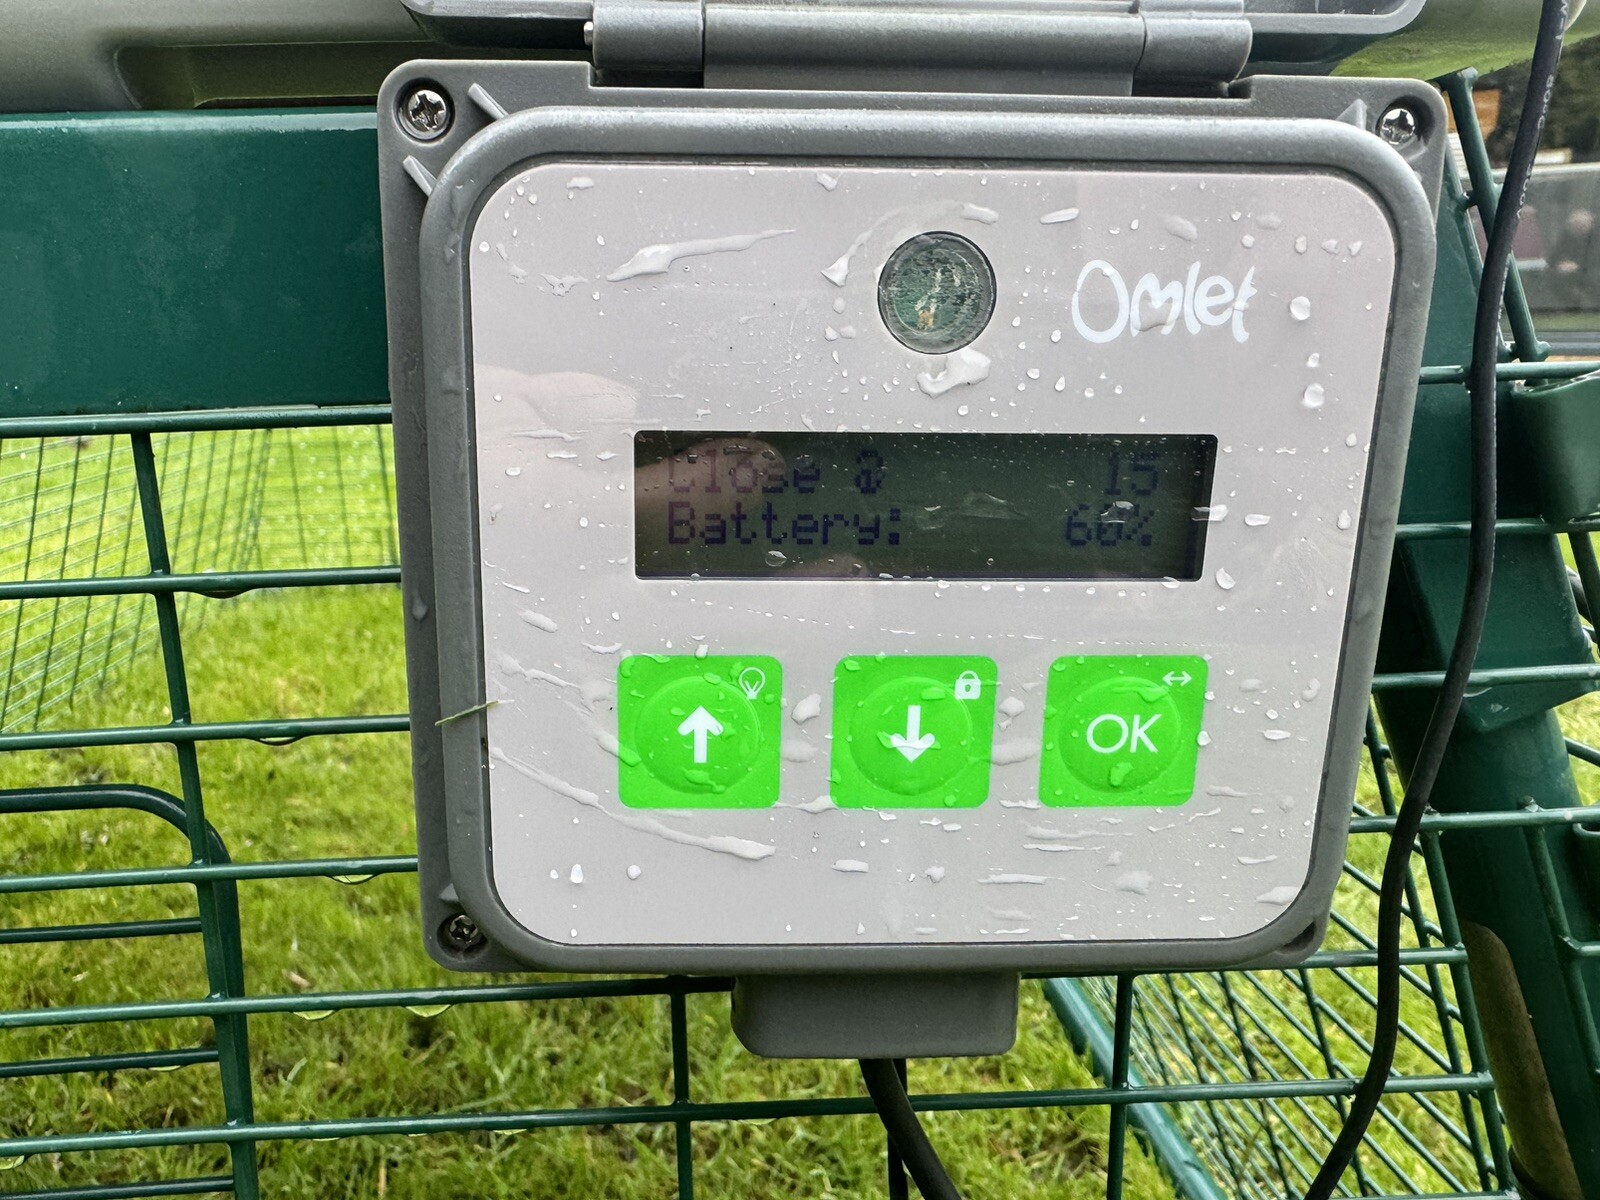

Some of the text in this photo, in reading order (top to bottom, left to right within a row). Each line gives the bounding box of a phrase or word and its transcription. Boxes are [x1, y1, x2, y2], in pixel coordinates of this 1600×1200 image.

[1072, 260, 1257, 343] Omlet
[1105, 452, 1160, 495] 15
[668, 501, 1155, 547] Battery: 60%
[1086, 713, 1162, 754] OK
